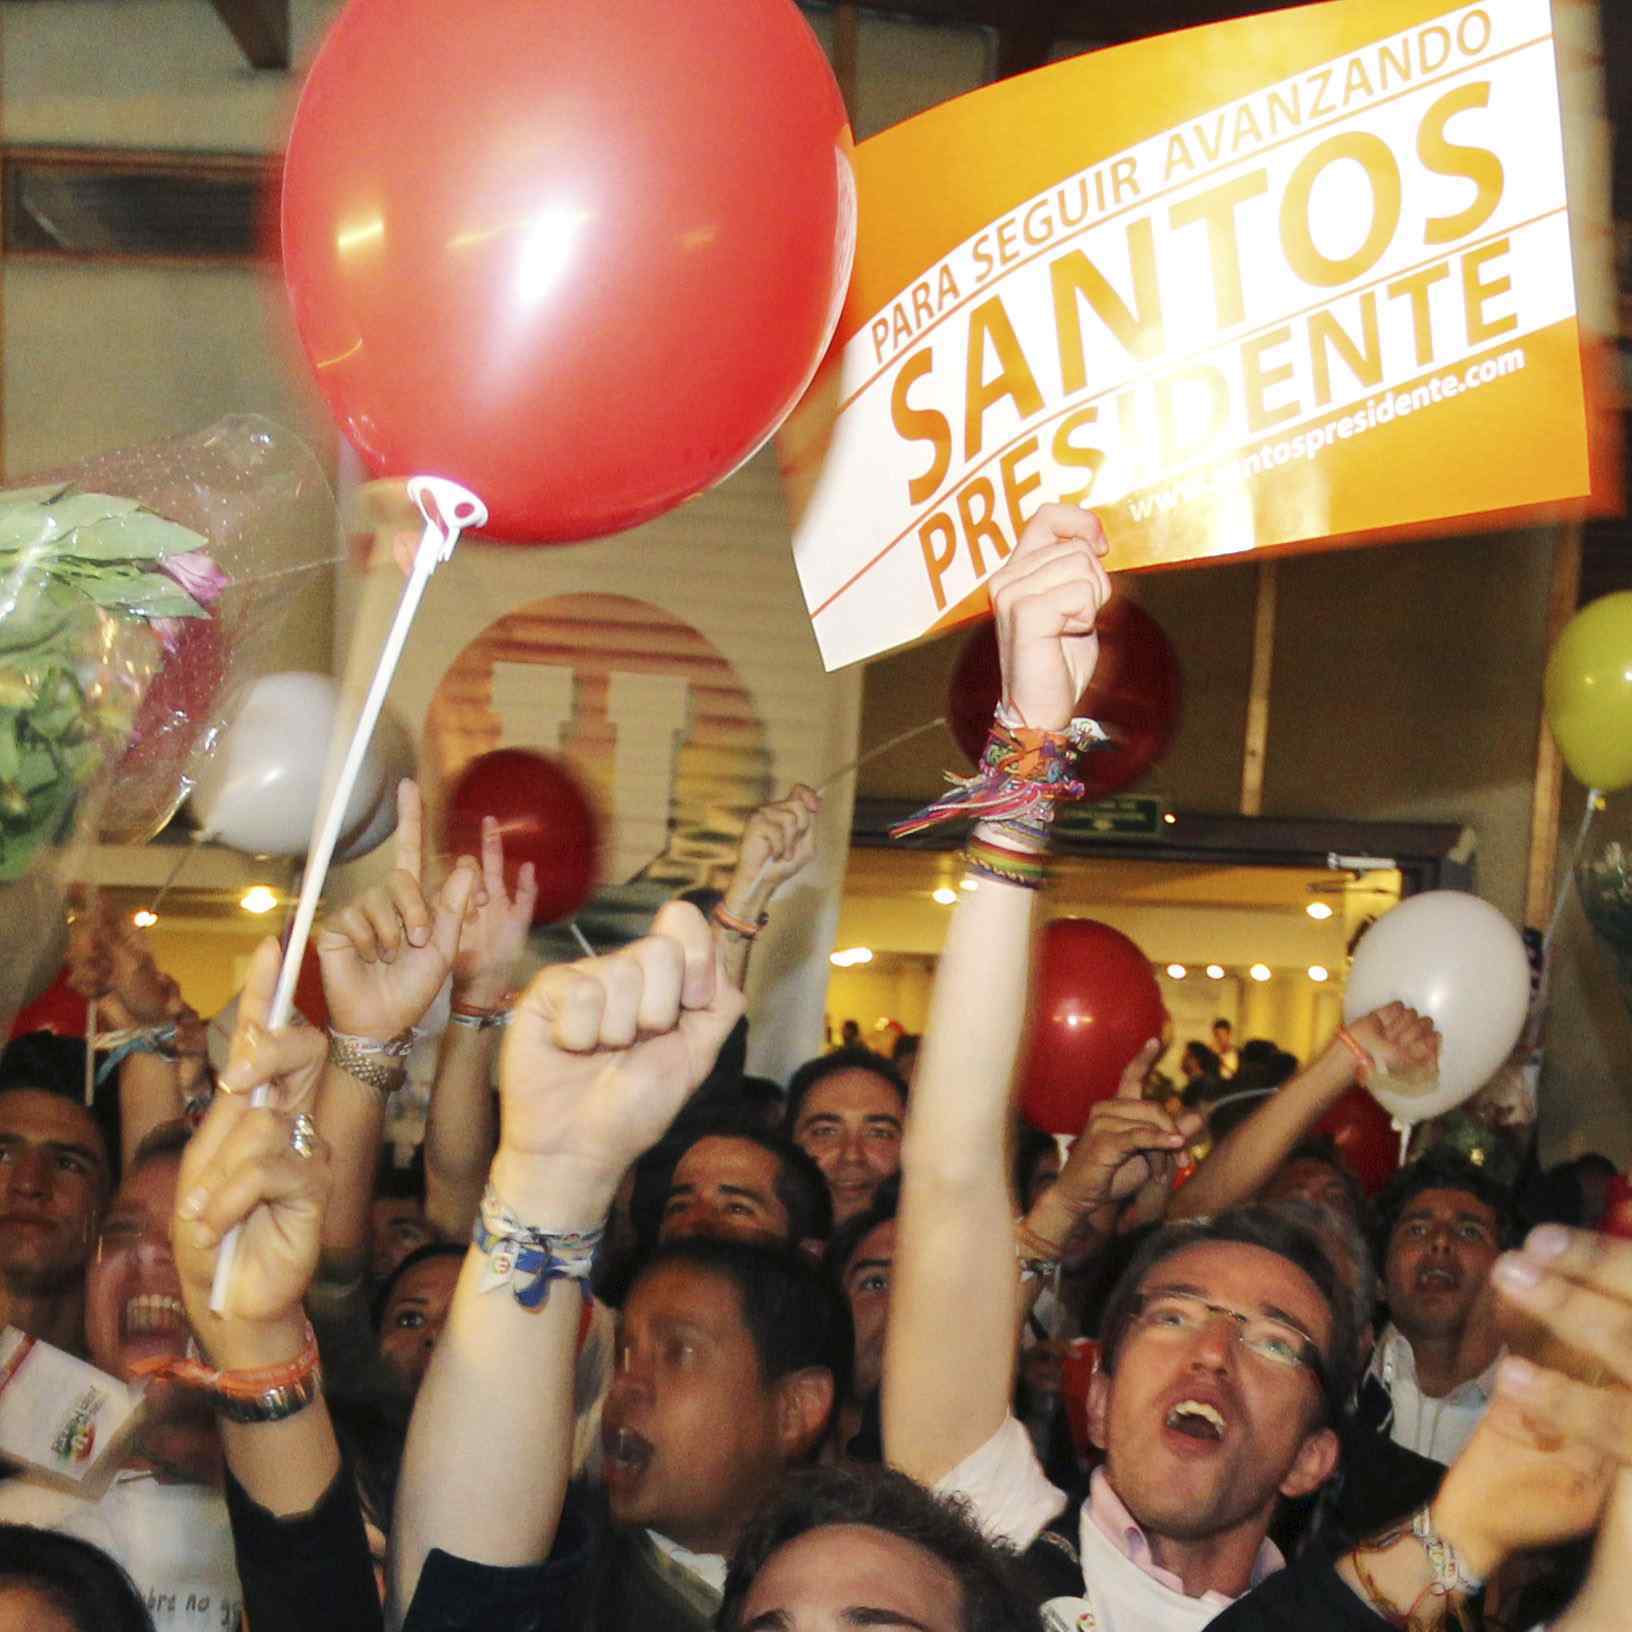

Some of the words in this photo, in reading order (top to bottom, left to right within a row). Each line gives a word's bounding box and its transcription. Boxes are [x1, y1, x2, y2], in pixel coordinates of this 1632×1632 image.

[870, 262, 960, 366] PARA
[971, 155, 1141, 281] SEGUIR
[1163, 8, 1494, 183] AVANZANDO
[889, 79, 1506, 508] SANTOS
